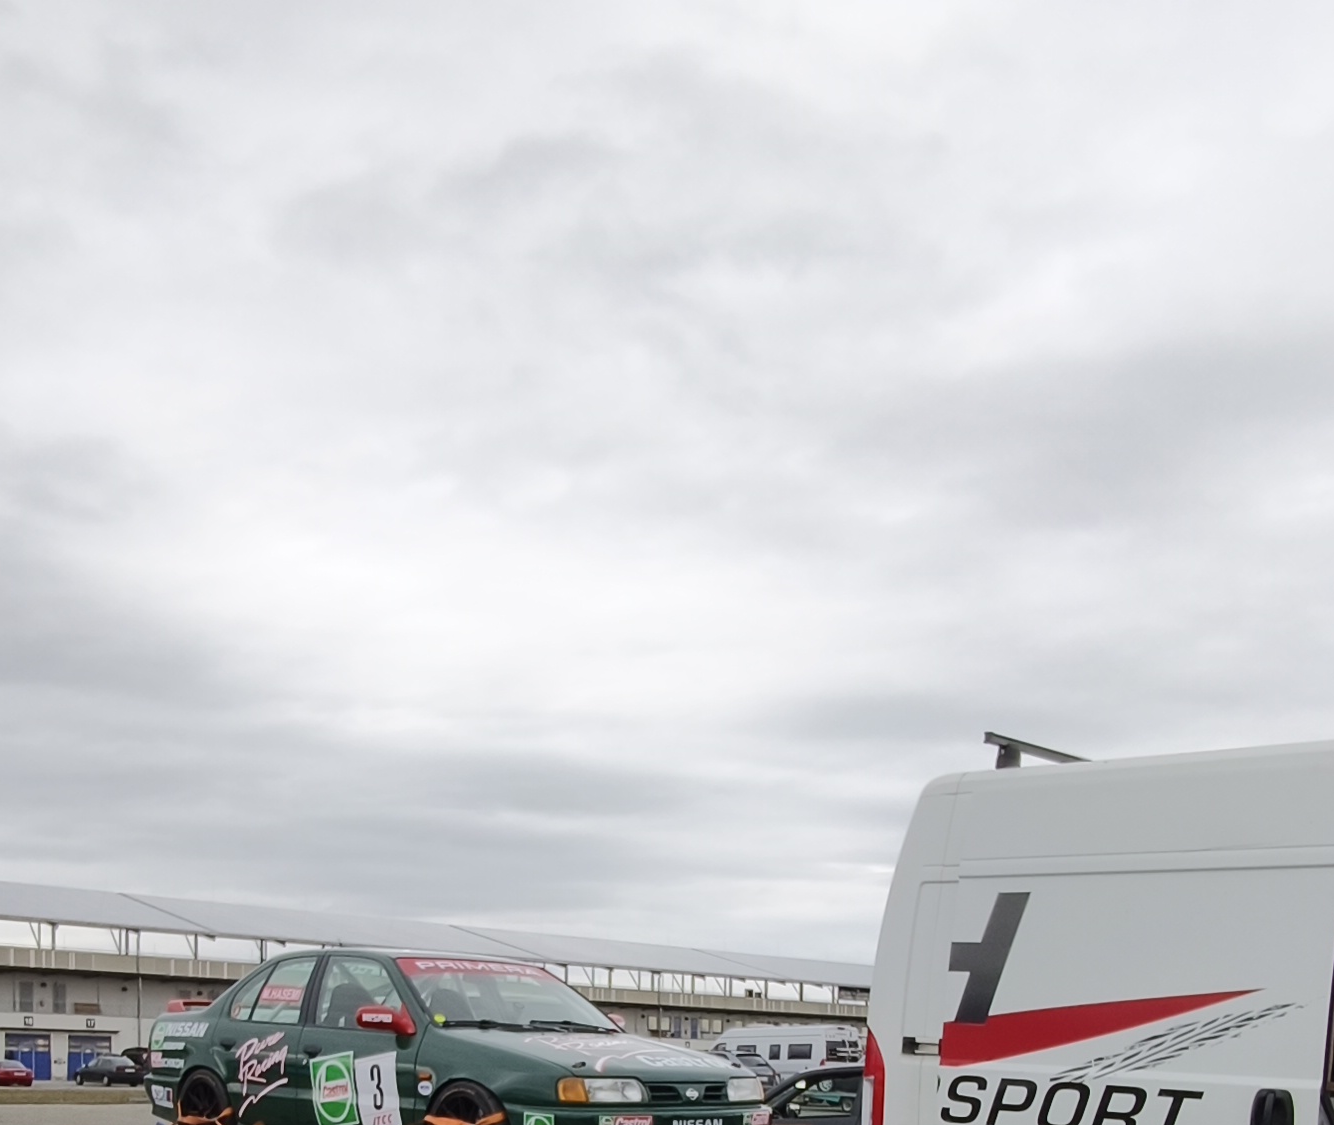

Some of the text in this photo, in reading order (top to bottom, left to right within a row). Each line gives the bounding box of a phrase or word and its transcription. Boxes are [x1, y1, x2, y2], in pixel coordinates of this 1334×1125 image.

[414, 960, 543, 978] PRIMERA
[167, 1021, 209, 1038] NISSAN
[240, 1045, 288, 1097] Racing
[369, 1064, 384, 1110] 3
